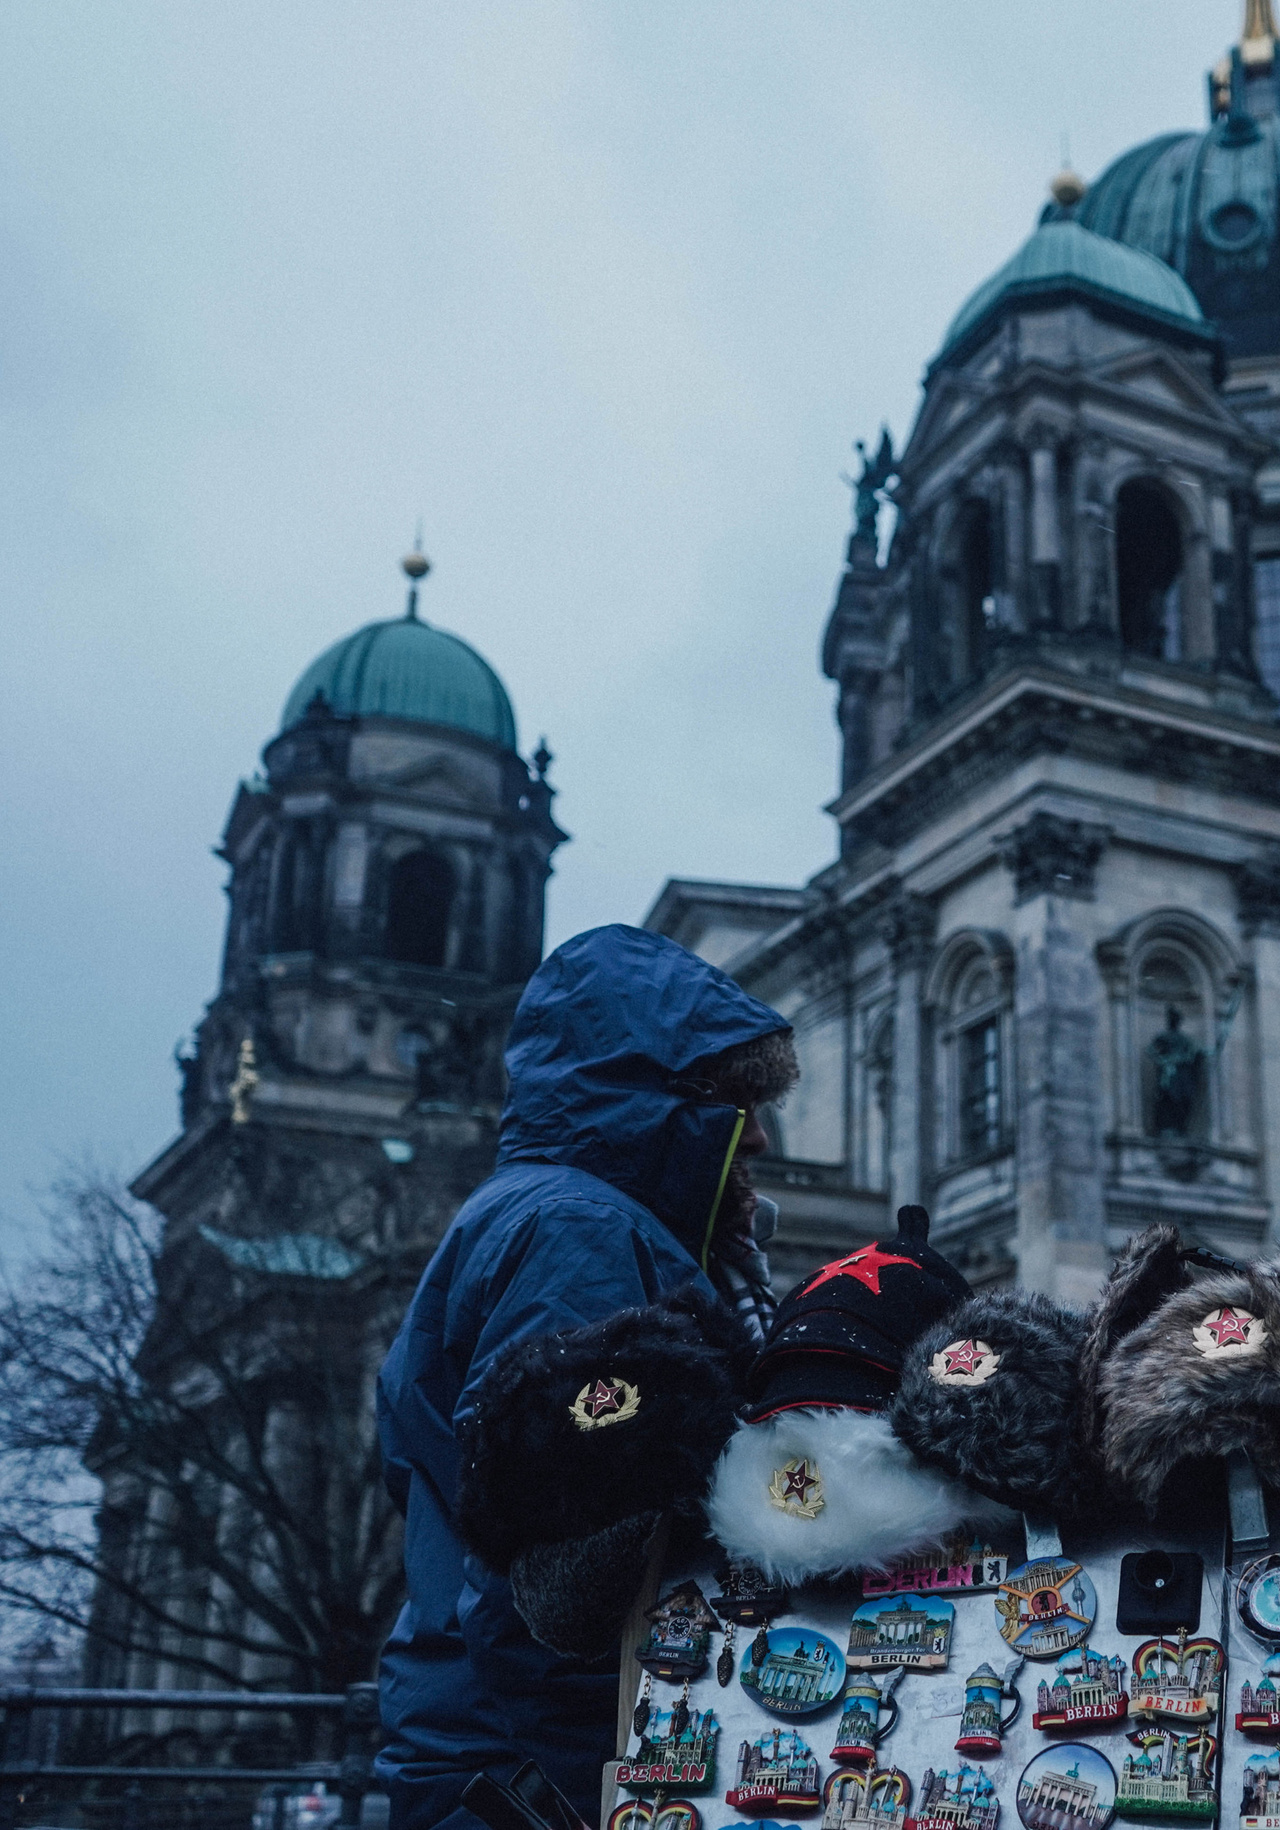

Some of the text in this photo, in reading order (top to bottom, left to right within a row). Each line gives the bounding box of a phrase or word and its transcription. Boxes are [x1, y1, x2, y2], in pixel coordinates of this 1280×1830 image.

[1028, 1607, 1063, 1621] BERLIN
[871, 1654, 921, 1664] BERLIN
[762, 1696, 802, 1711] BERLIN
[1145, 1696, 1201, 1713] BERLIN
[1066, 1704, 1118, 1721] BERLIN
[1137, 1728, 1171, 1741] BERLIN
[615, 1762, 707, 1784] BERLIN
[738, 1786, 776, 1802] BERLIN
